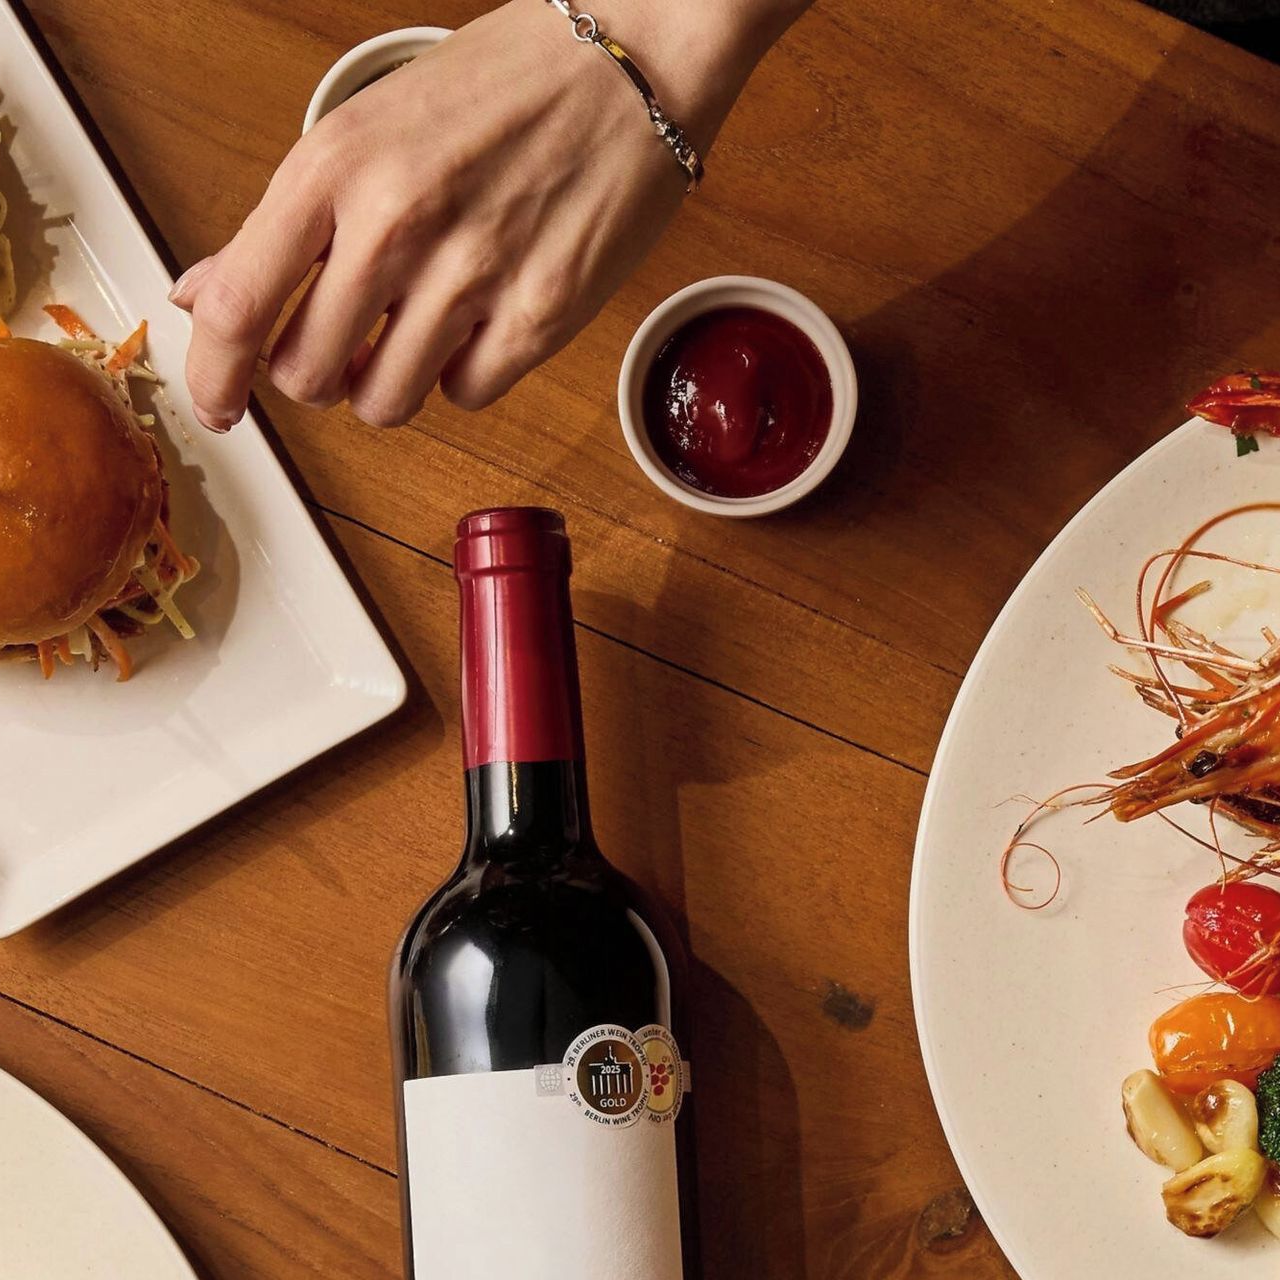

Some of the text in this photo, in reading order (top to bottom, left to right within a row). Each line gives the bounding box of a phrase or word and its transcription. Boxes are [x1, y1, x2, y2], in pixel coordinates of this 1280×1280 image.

[573, 1029, 606, 1055] BERLINER
[607, 1028, 628, 1039] WEIN
[629, 1037, 648, 1066] TROPHY
[601, 1065, 621, 1074] 2025
[584, 1109, 610, 1125] BERLIN
[612, 1114, 632, 1125] WINE
[632, 1088, 649, 1117] TROPHY
[600, 1098, 627, 1108] GOLD
